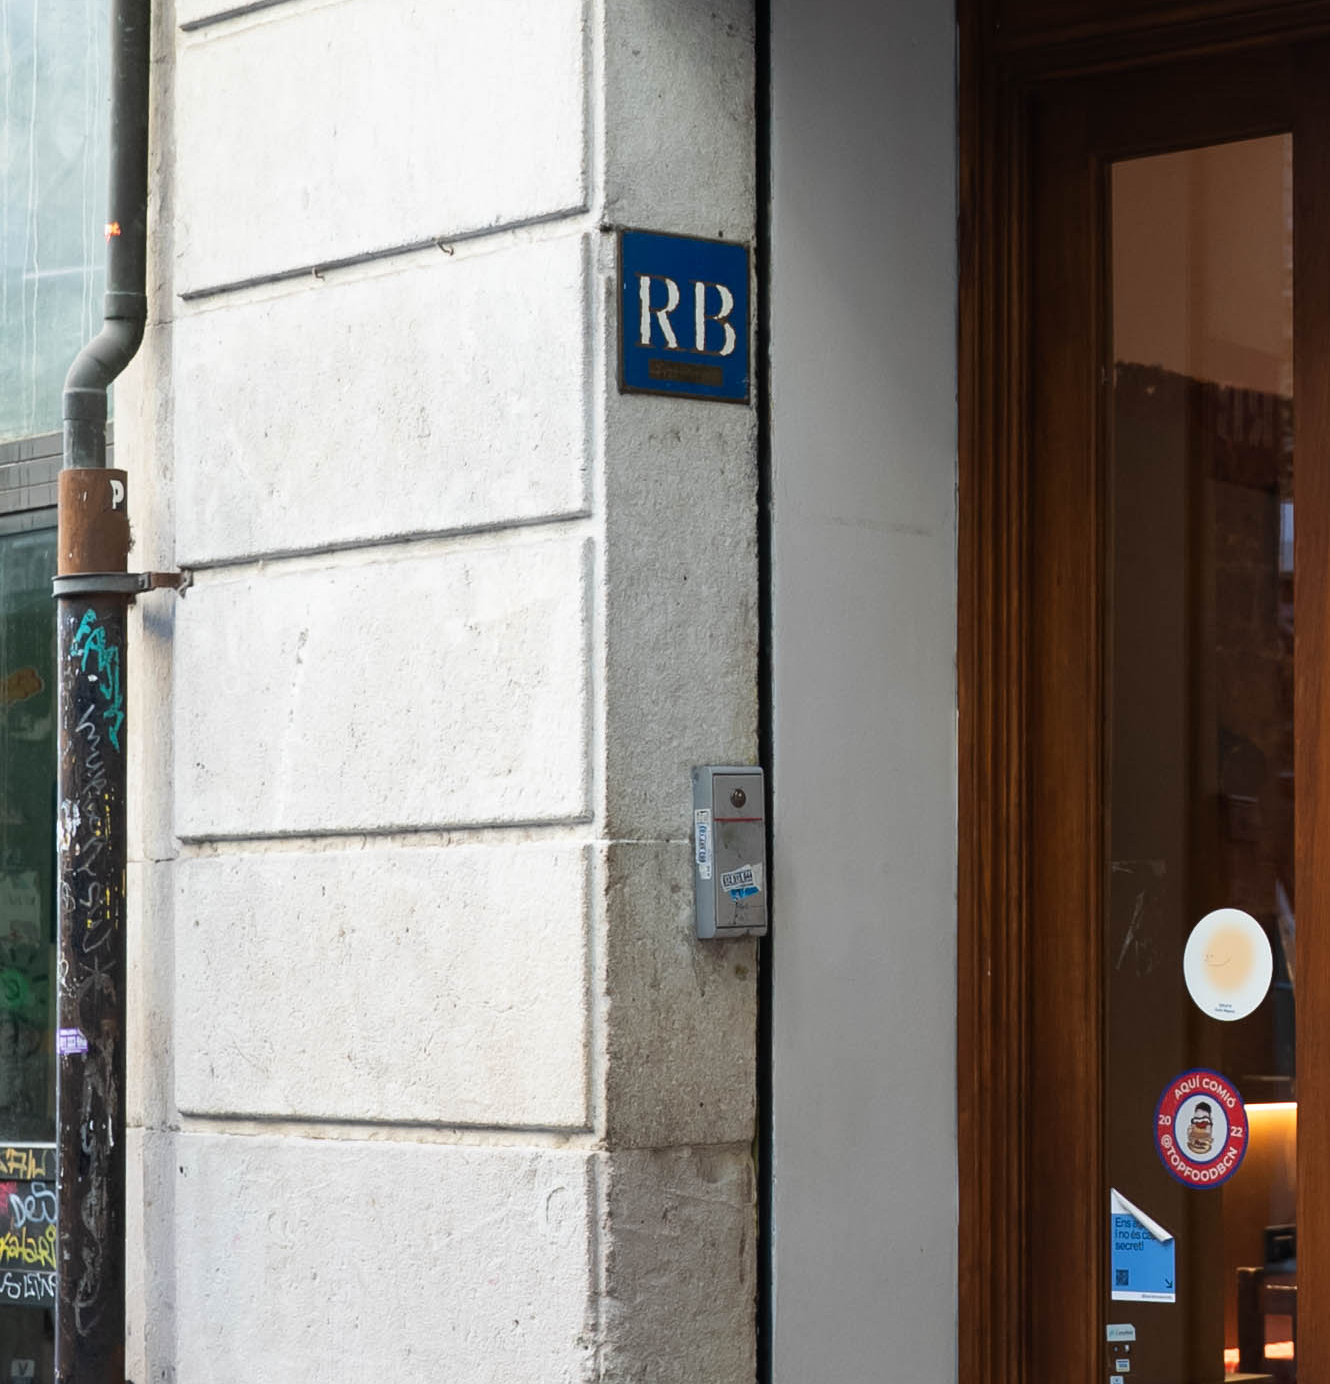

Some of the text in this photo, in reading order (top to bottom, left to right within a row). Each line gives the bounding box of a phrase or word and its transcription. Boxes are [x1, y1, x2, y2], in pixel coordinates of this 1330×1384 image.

[634, 272, 737, 357] RB
[1174, 1075, 1236, 1109] AQUÍ COMIÓ
[1158, 1114, 1172, 1126] 20
[1230, 1125, 1243, 1138] 22
[1160, 1133, 1239, 1182] @TOPFOODBCN
[1118, 1231, 1130, 1239] no
